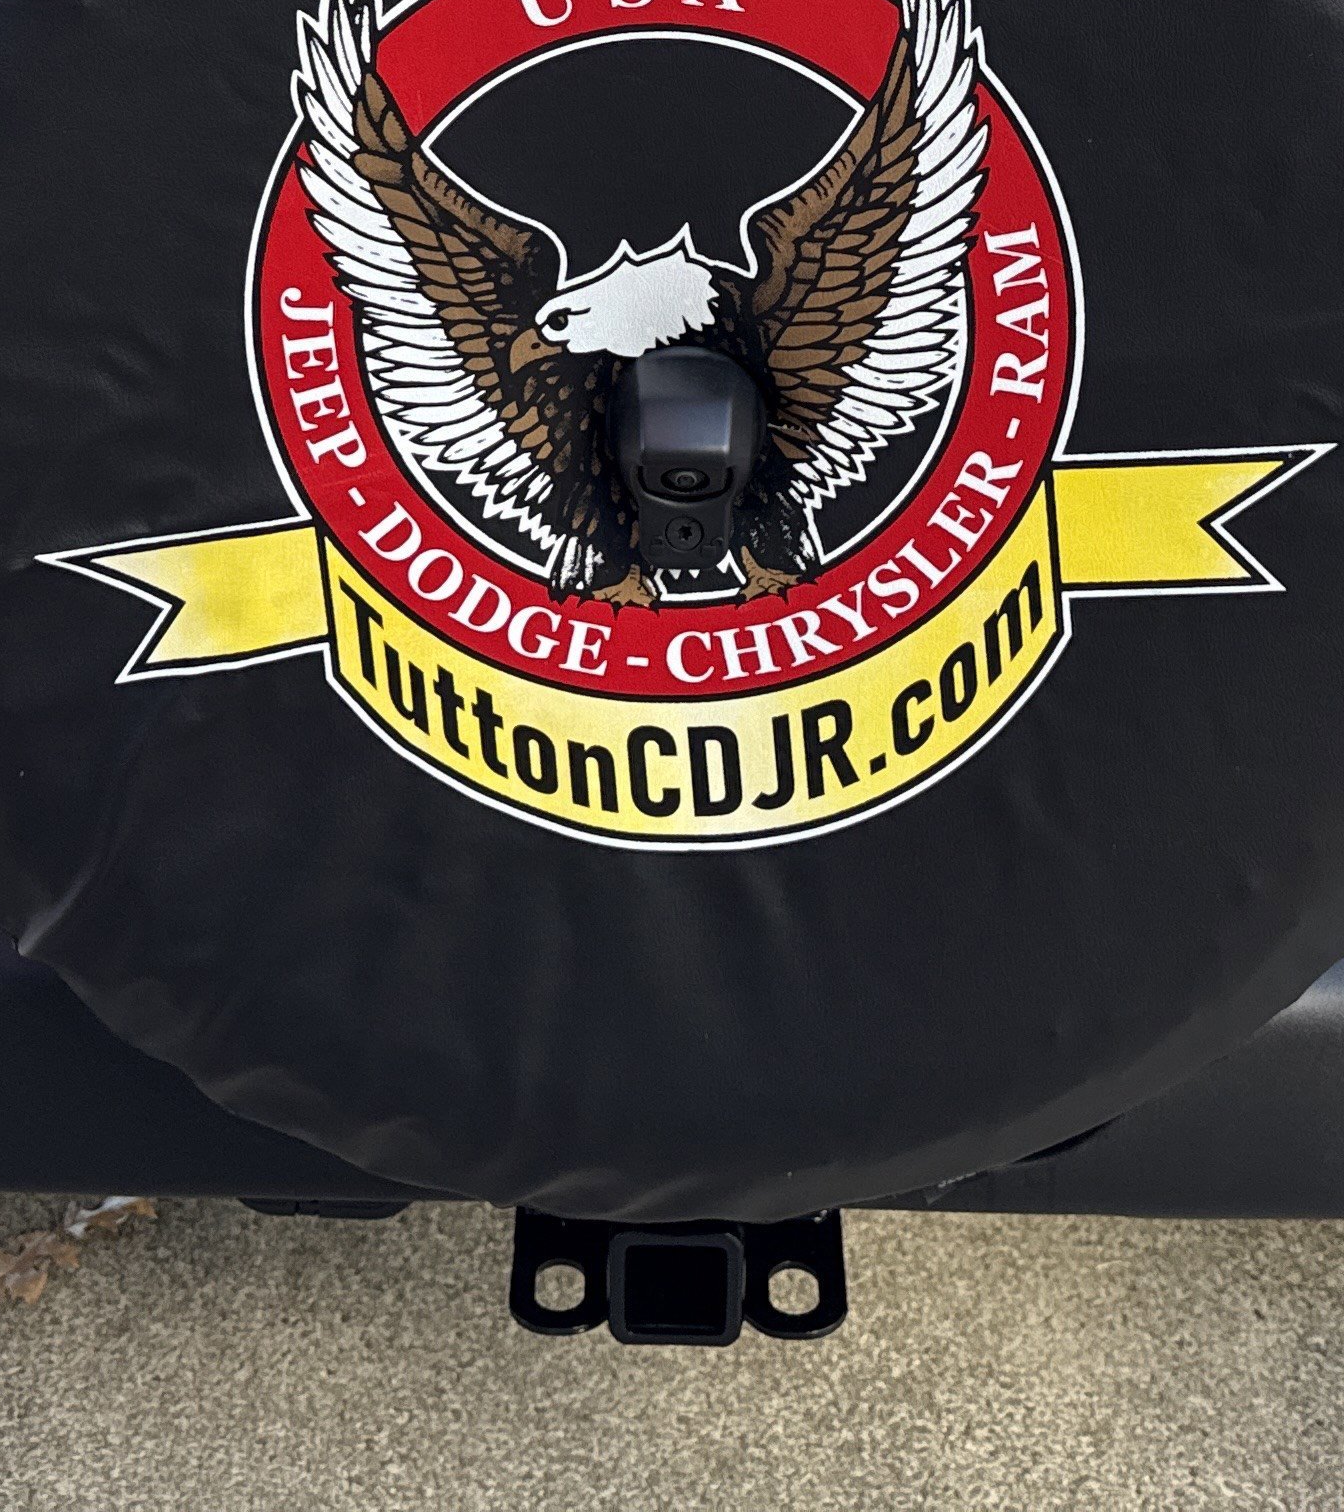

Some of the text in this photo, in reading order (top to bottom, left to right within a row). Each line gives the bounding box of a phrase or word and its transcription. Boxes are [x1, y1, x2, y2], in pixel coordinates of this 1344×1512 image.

[281, 288, 366, 467] JEEP
[359, 502, 611, 675] DODGE
[667, 452, 1023, 682] CHRYSLER
[984, 223, 1049, 403] RAM
[339, 560, 1044, 819] TuttonCDJR.com
